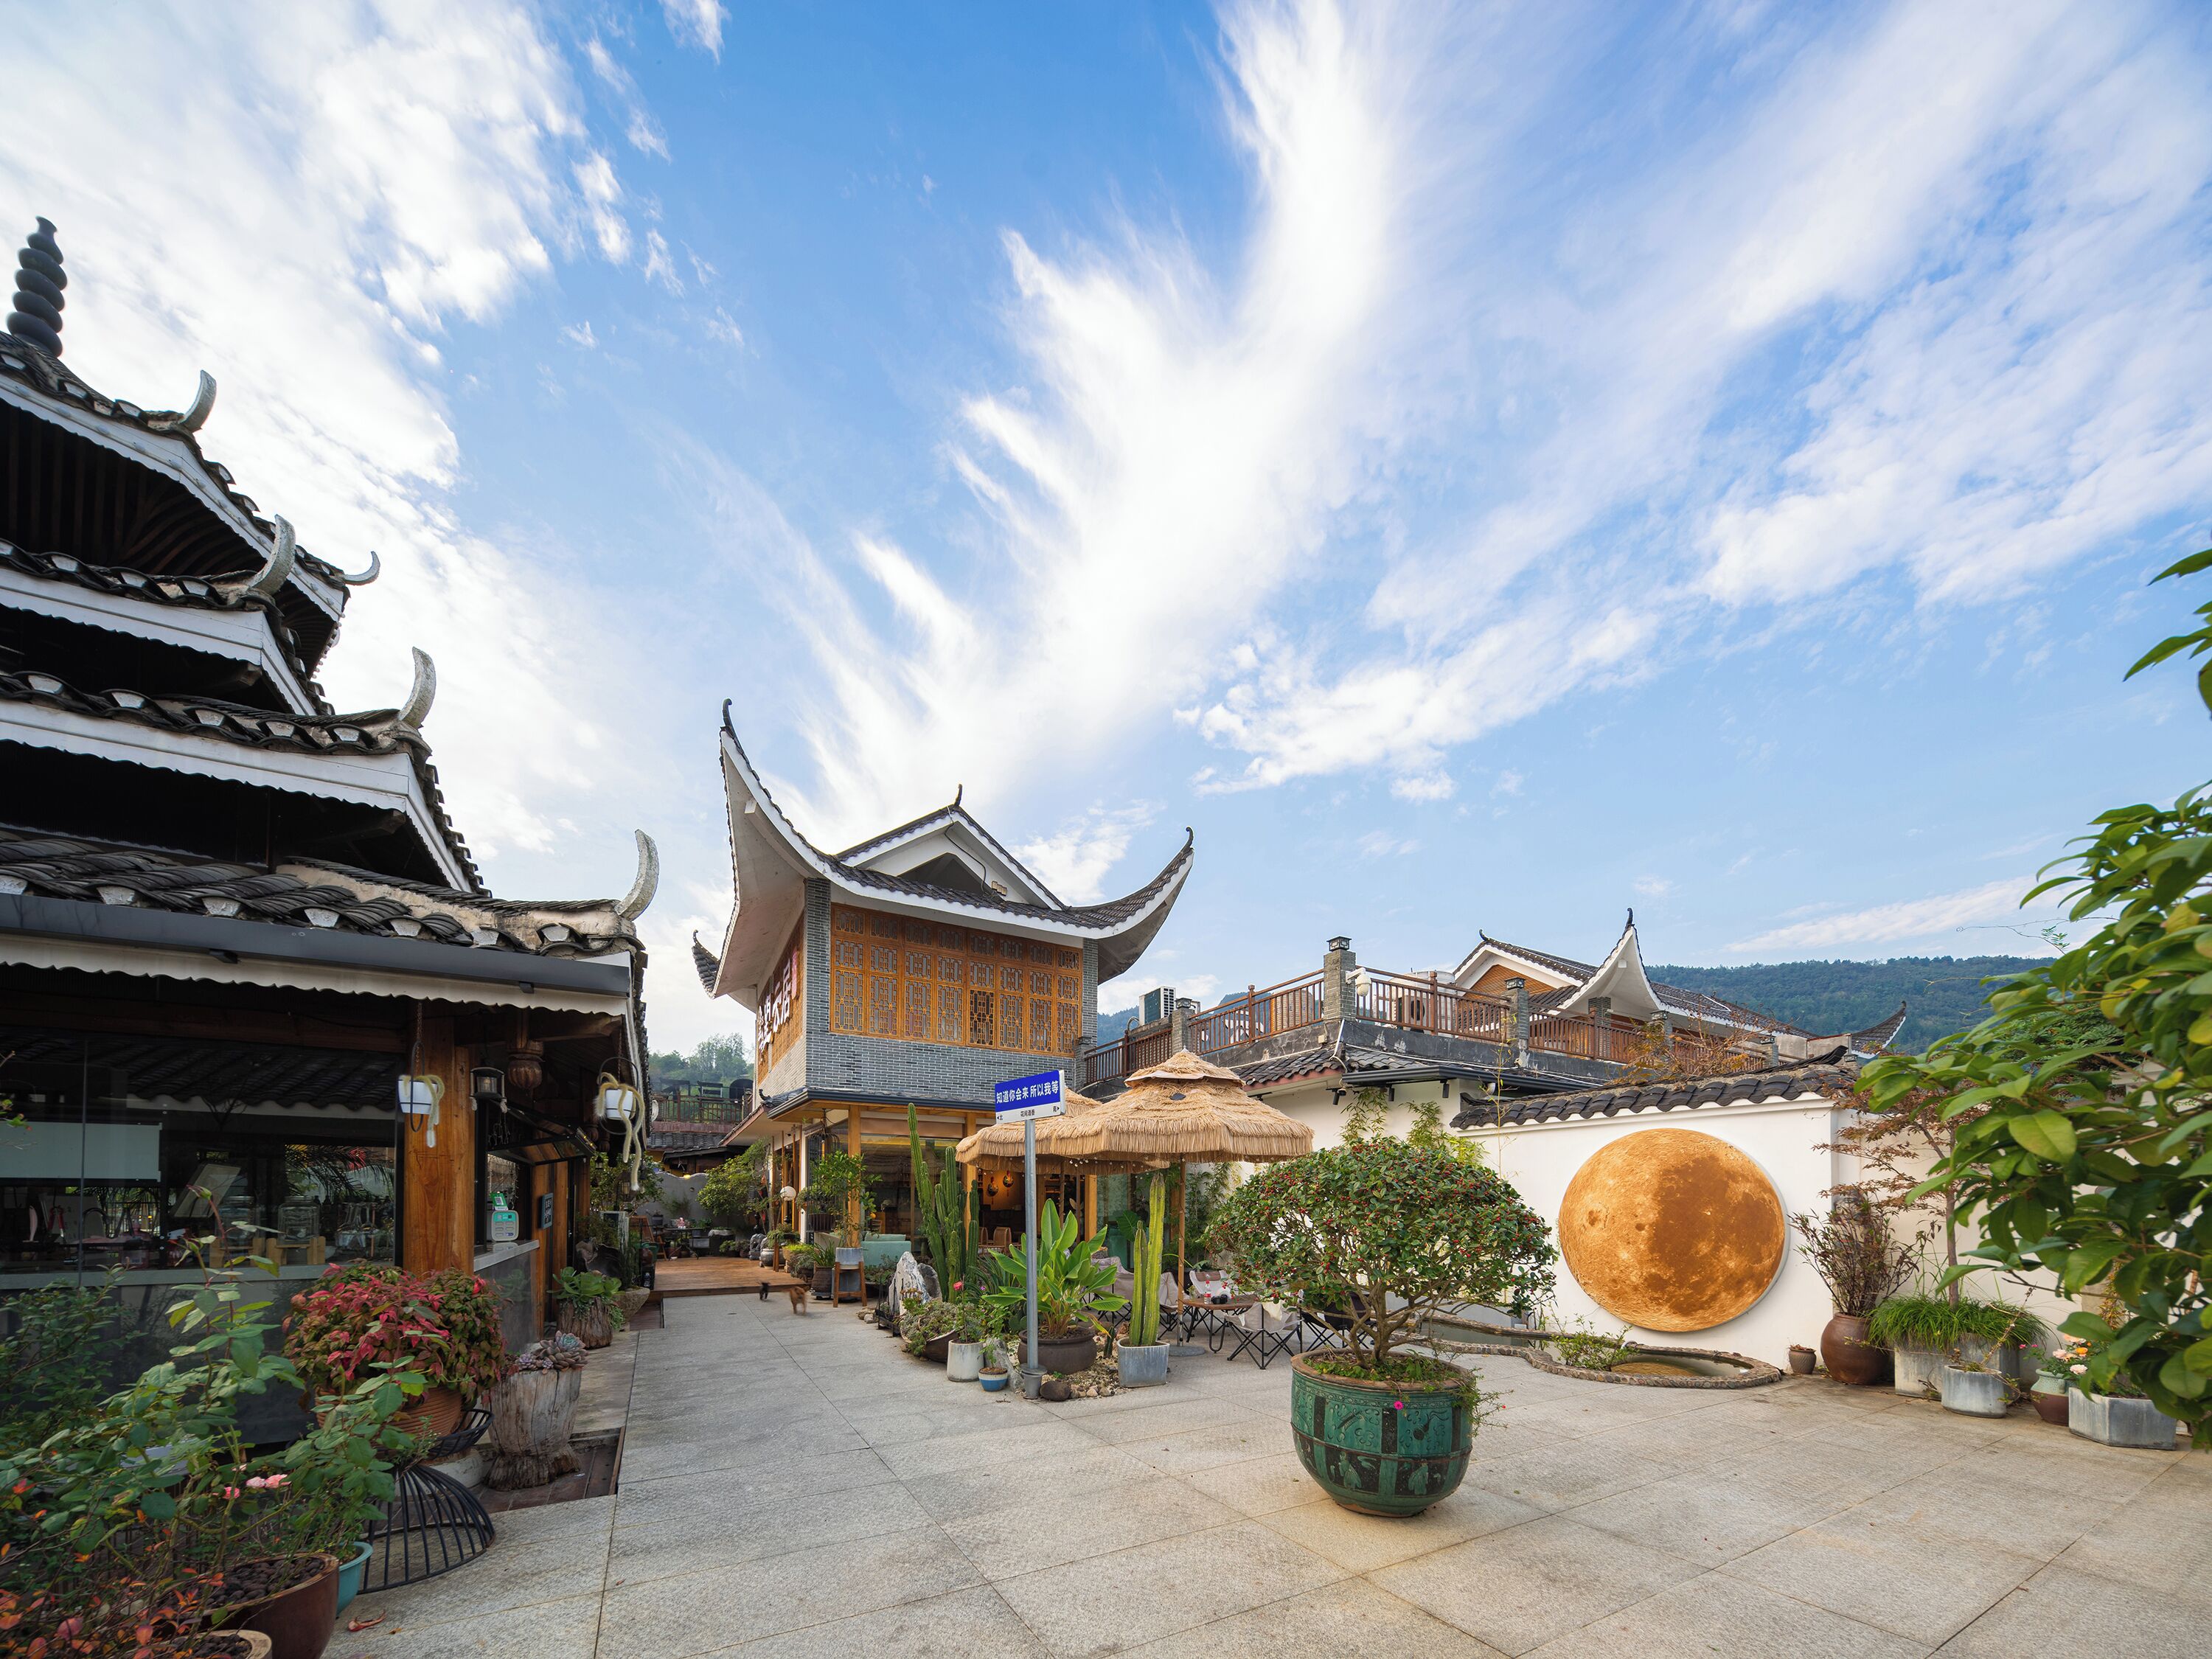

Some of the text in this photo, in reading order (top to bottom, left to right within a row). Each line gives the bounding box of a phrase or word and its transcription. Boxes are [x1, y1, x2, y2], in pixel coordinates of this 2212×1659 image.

[996, 1080, 1059, 1104] 知道你会来 所以我等
